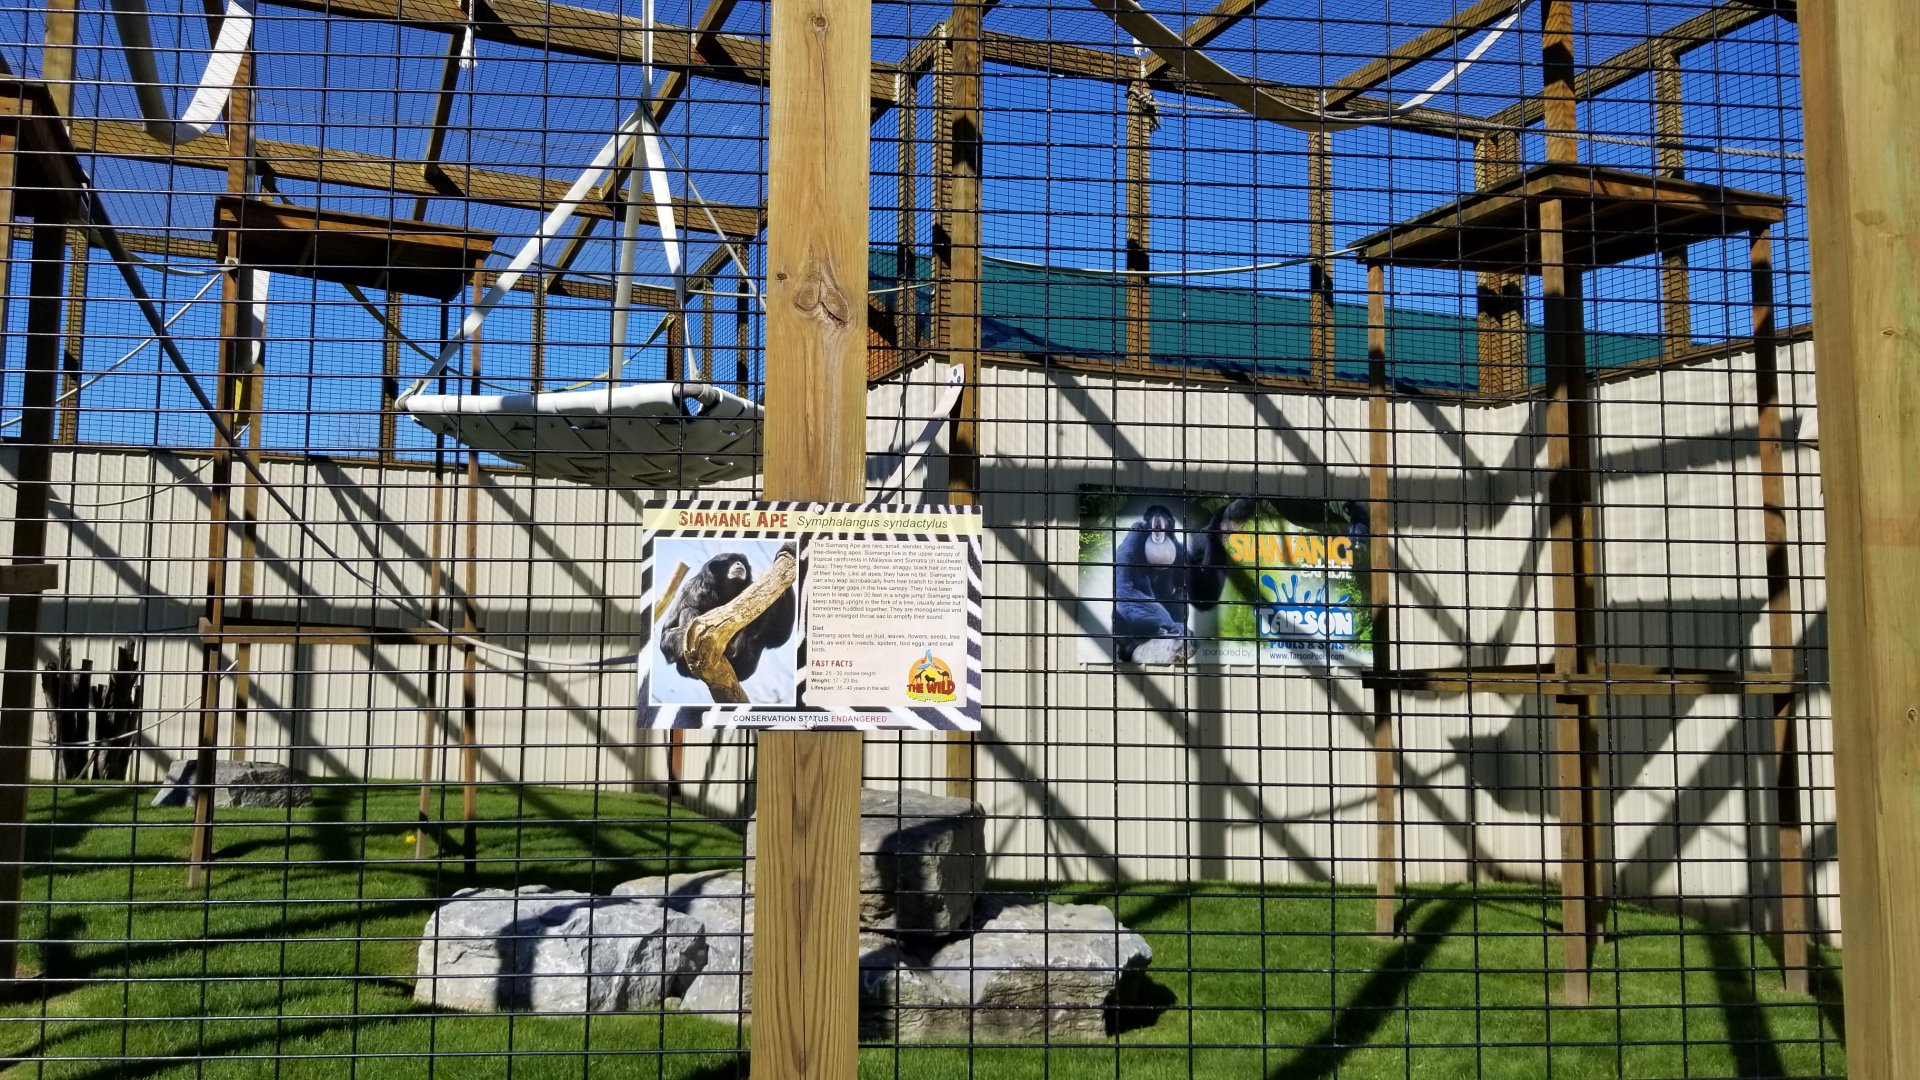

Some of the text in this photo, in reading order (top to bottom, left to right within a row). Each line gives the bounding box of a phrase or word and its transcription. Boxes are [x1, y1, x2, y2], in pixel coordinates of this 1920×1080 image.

[679, 511, 948, 530] SIAMANG APE Symphalangus syndactylus
[1270, 652, 1344, 660] www.TarsonPoolscom
[907, 680, 956, 695] THE WILD
